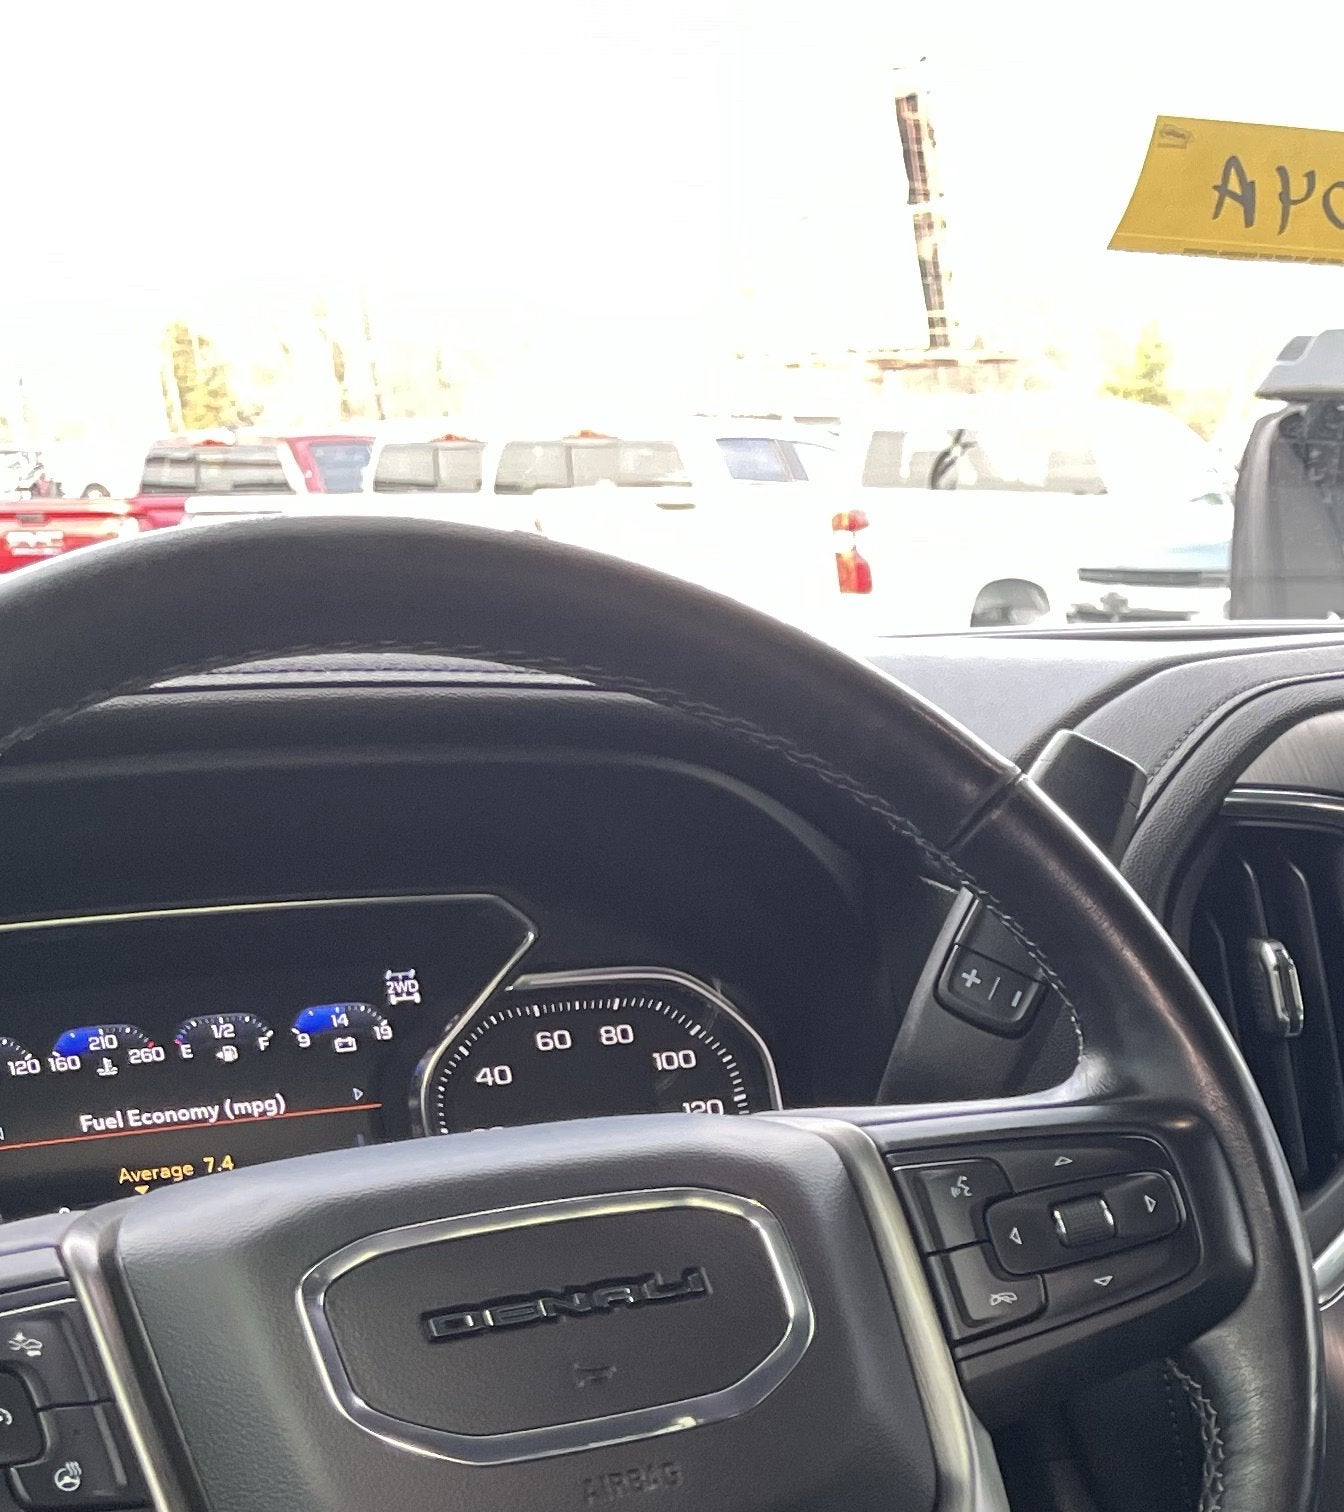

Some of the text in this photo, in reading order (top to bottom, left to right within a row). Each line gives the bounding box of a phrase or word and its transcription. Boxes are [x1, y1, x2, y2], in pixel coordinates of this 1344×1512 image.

[386, 979, 419, 996] 2WD
[330, 1012, 349, 1028] 14
[210, 1022, 236, 1041] 1/2
[298, 1032, 311, 1048] 9
[373, 1024, 393, 1040] 19
[536, 1029, 572, 1051] 60
[600, 1023, 634, 1046] 80
[88, 1033, 118, 1051] 210
[258, 1036, 270, 1053] F
[128, 1045, 165, 1064] 260
[180, 1044, 193, 1061] E
[653, 1049, 697, 1071] 100
[7, 1057, 41, 1075] 120
[48, 1055, 81, 1072] 160
[476, 1064, 513, 1086] 40
[80, 1093, 286, 1133] Fuel Economy (mpg)
[118, 1152, 235, 1185] Average 7.4
[421, 1266, 714, 1343] DENALI
[583, 1460, 685, 1503] AIRBAG
